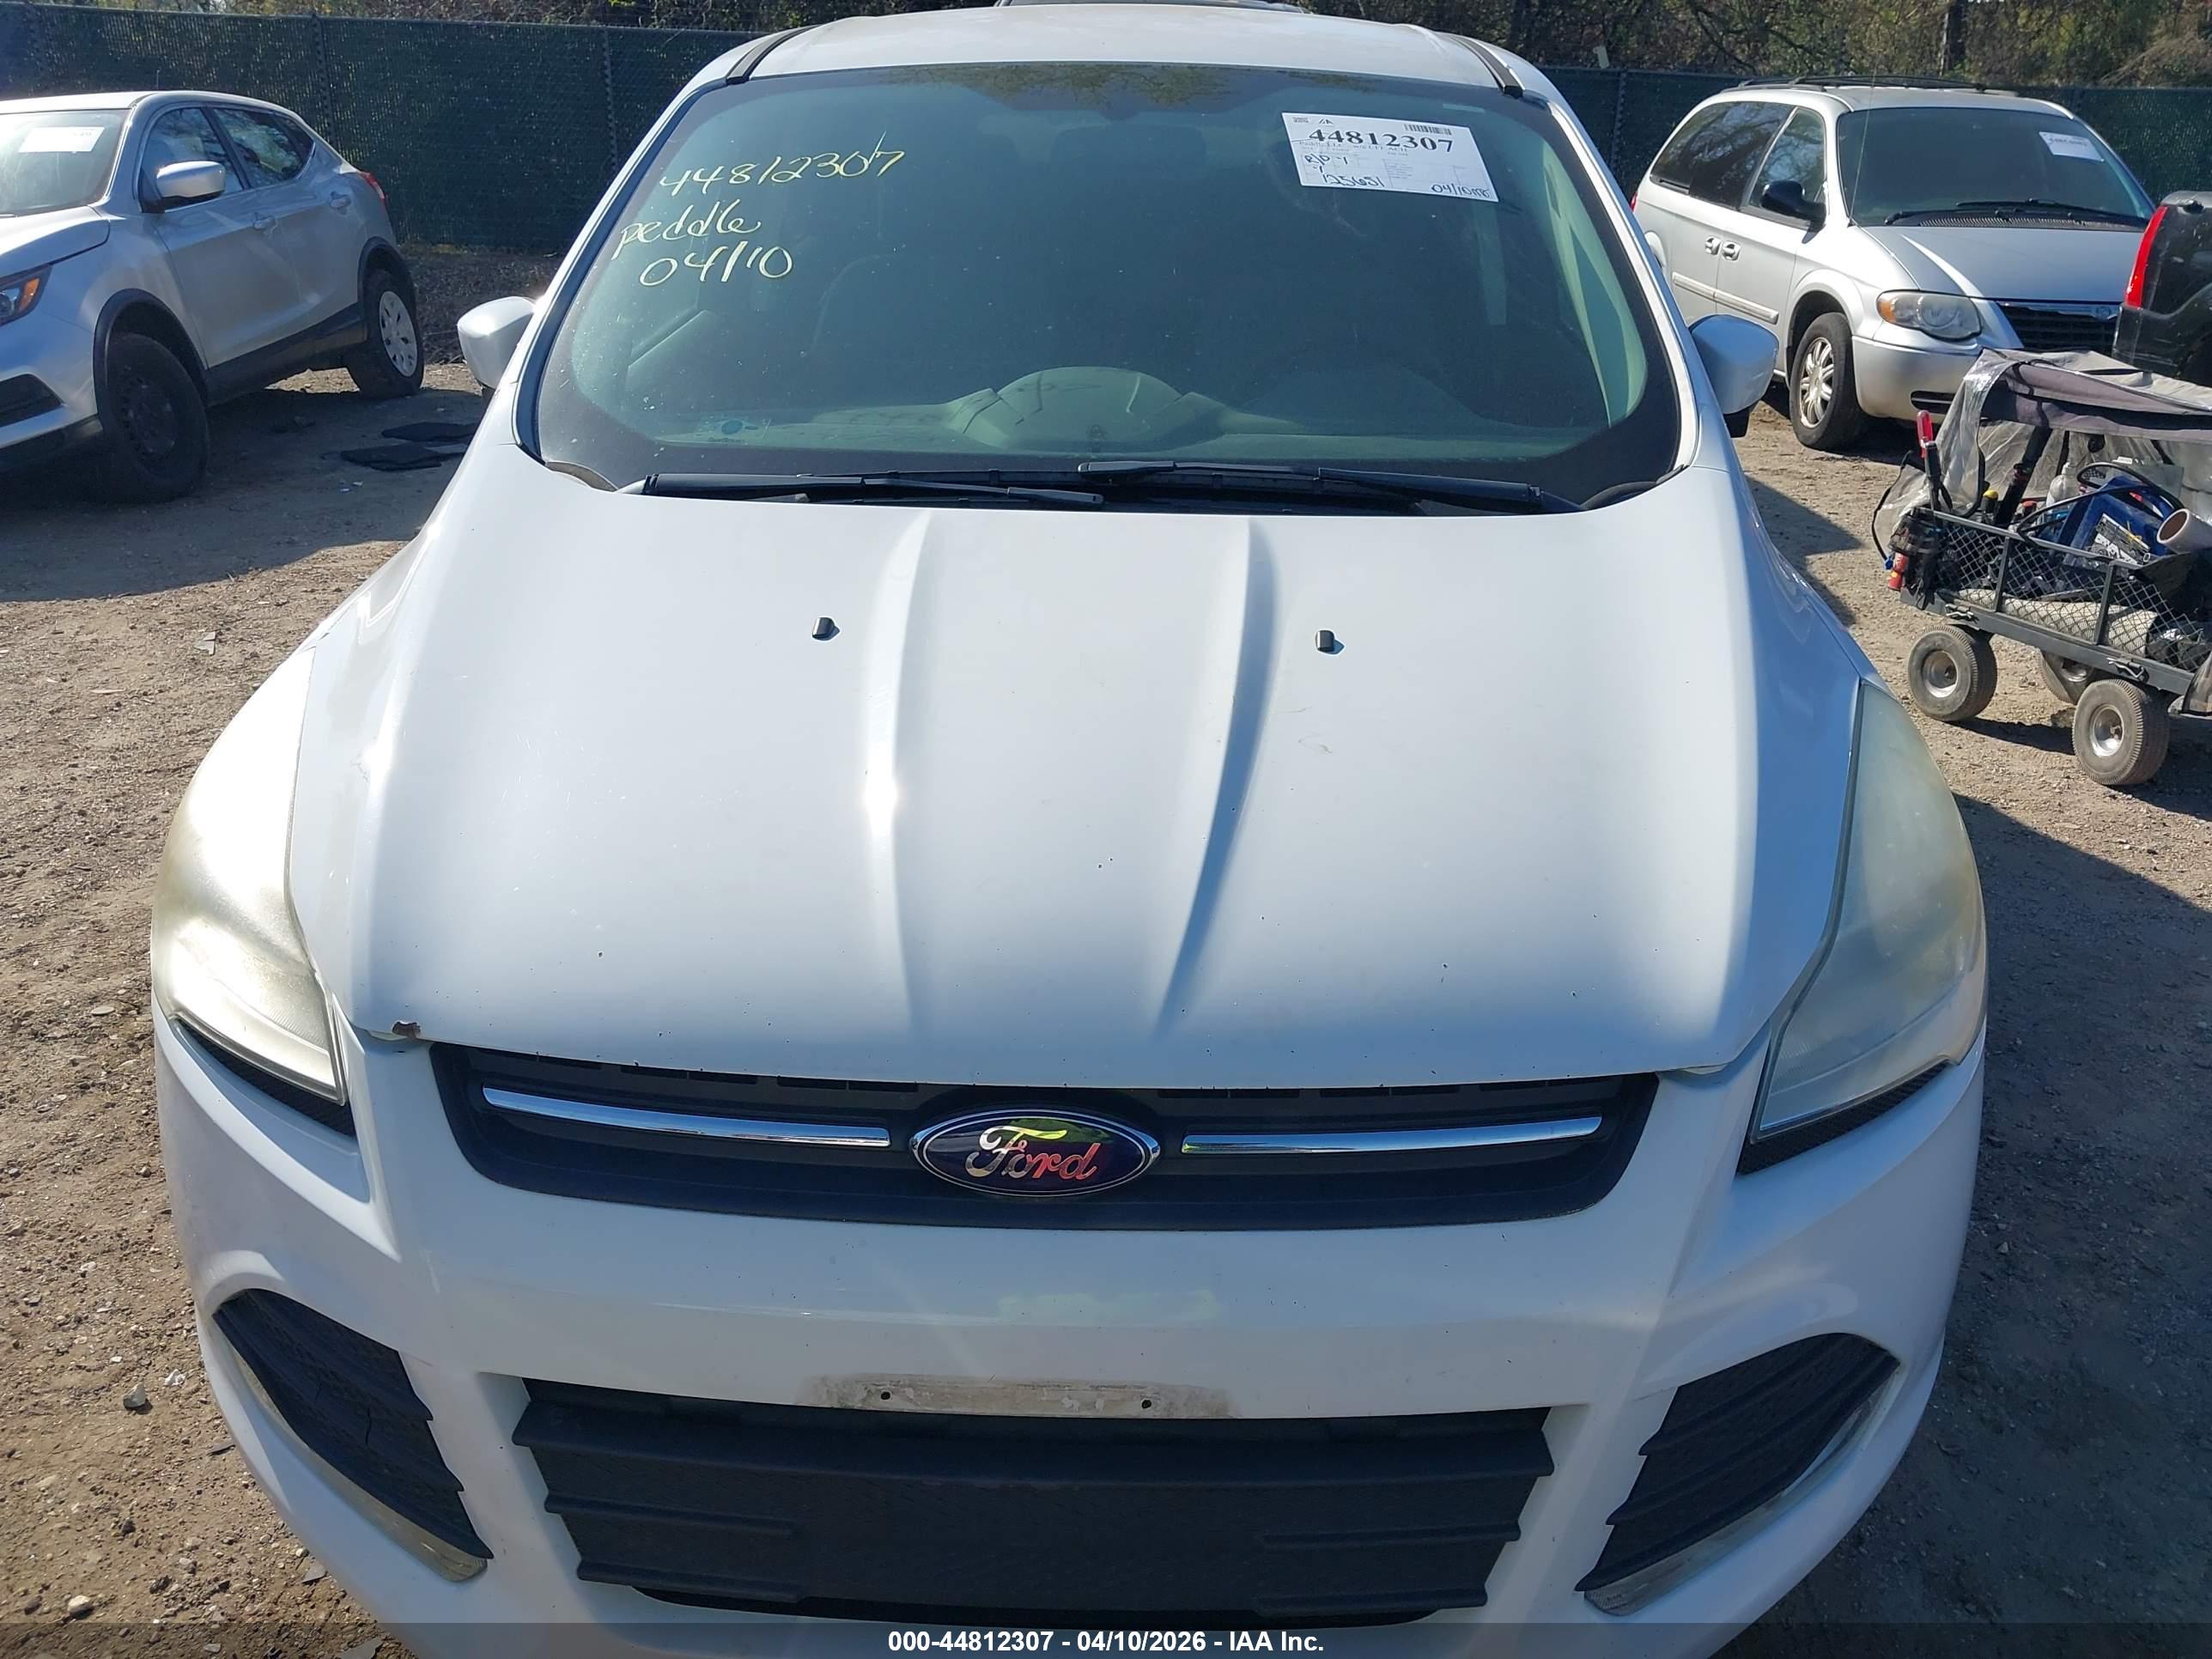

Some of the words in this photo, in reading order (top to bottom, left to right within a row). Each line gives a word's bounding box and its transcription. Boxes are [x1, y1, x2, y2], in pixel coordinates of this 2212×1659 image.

[659, 131, 905, 197] 44812307
[1309, 129, 1453, 153] 44812307
[639, 240, 793, 287] 04/10
[964, 1125, 1102, 1181] Ford
